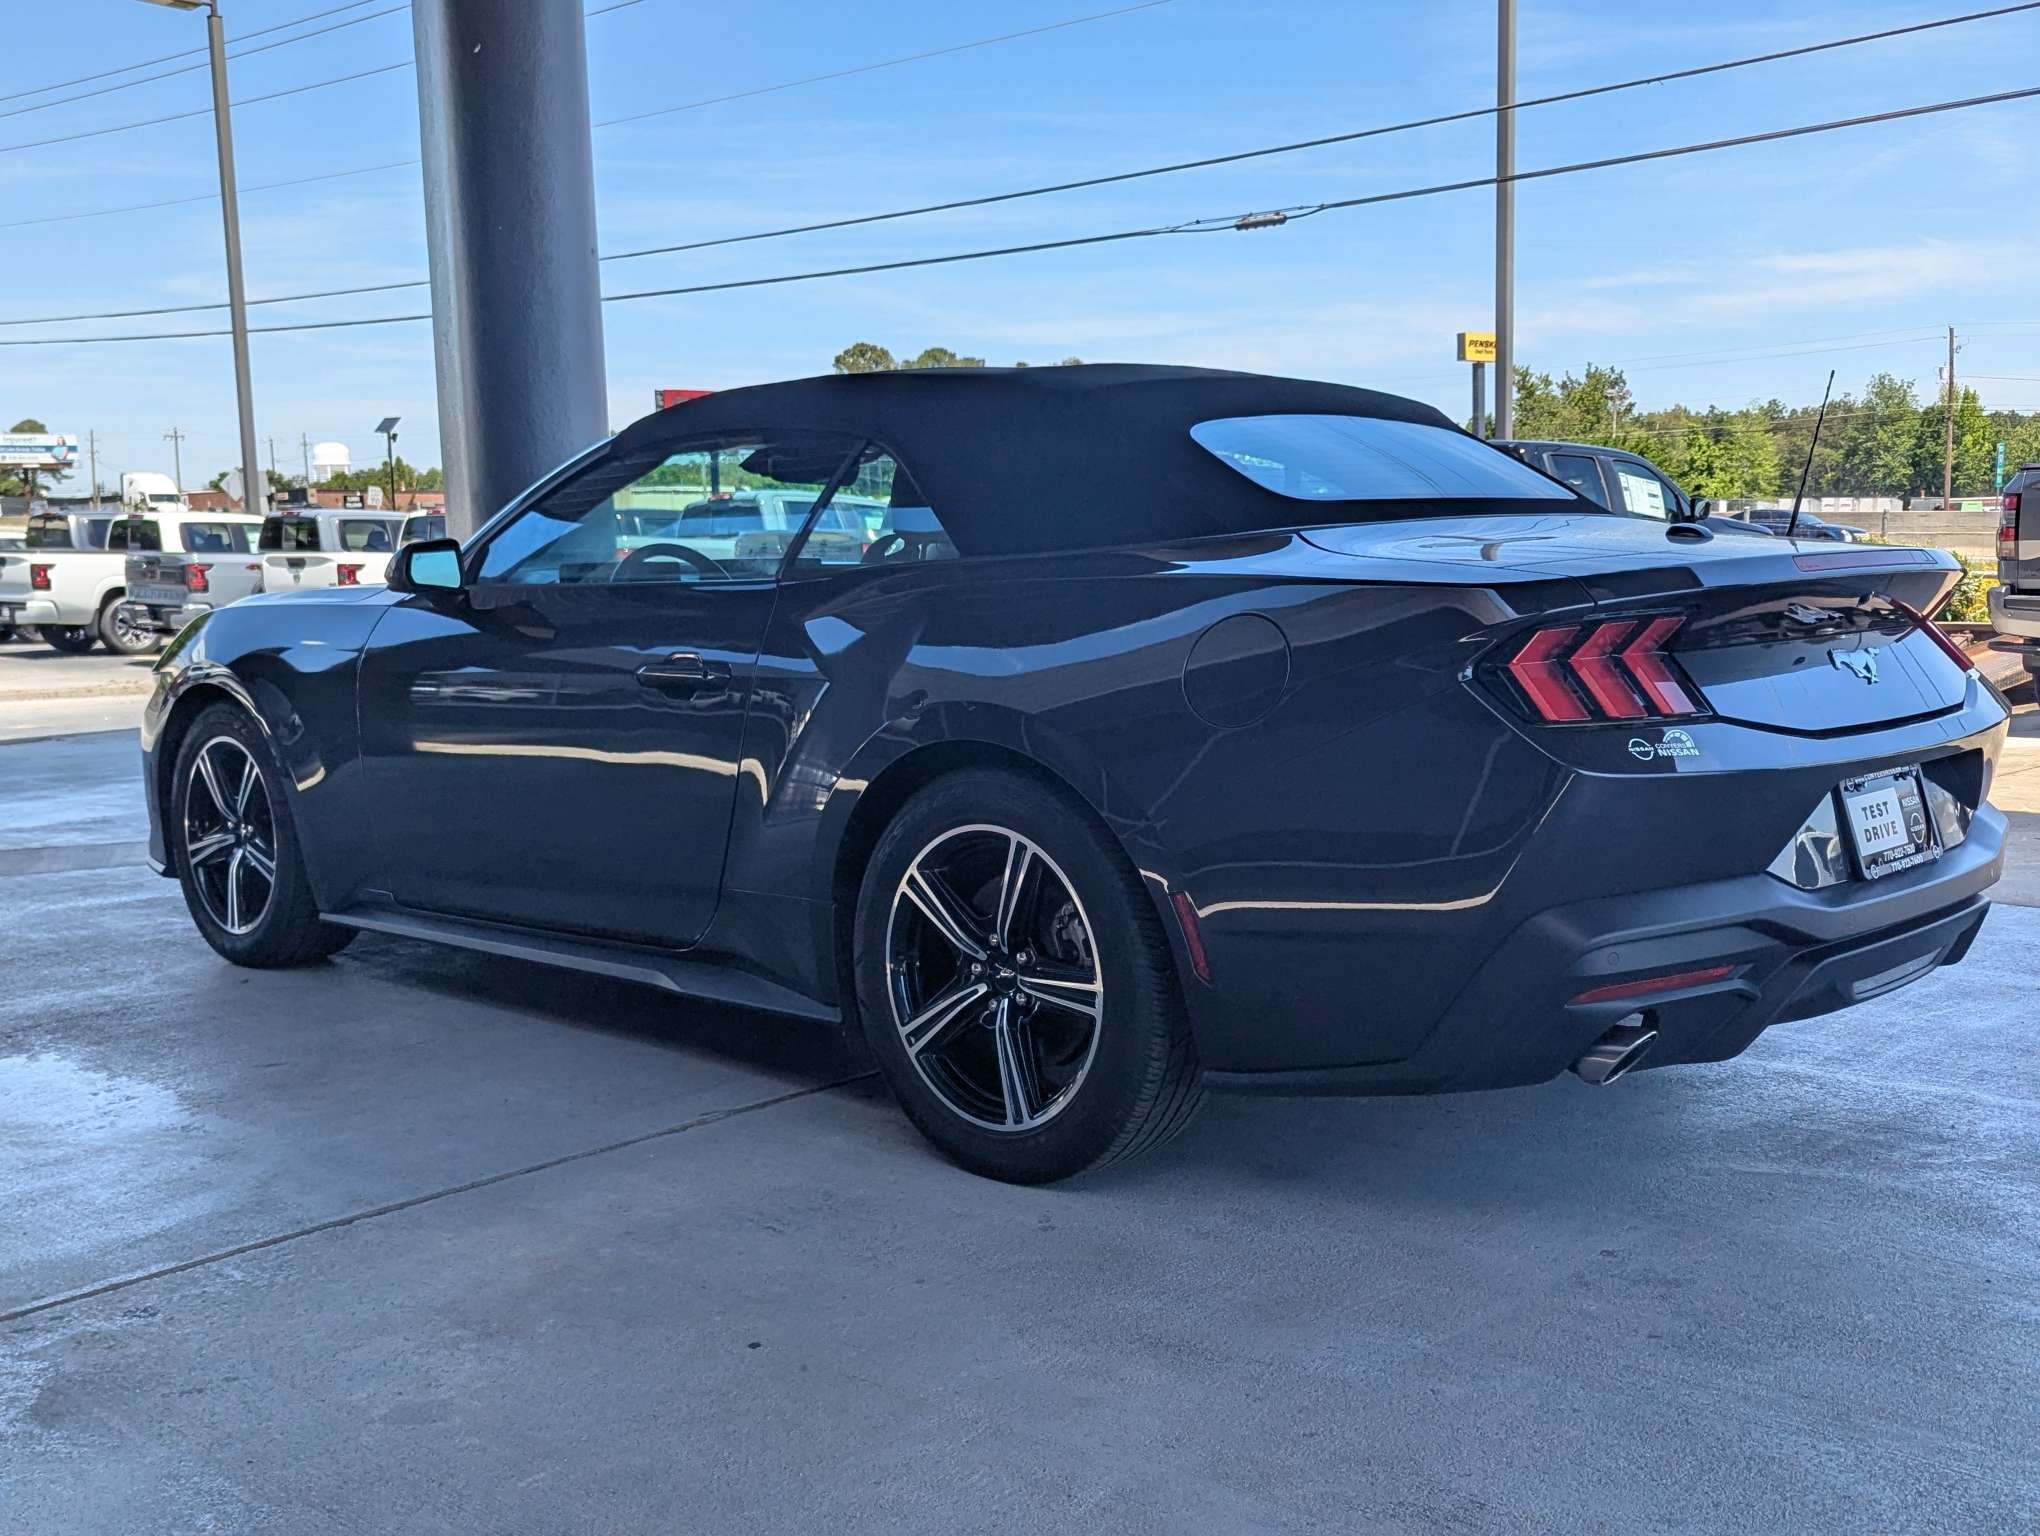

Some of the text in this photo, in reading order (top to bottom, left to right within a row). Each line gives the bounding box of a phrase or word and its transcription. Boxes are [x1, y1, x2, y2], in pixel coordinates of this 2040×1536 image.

[1468, 339, 1497, 349] PENSK
[1657, 748, 1700, 756] NISSAN
[1901, 796, 1920, 807] NISSAN
[1861, 801, 1890, 821] TEST
[1864, 820, 1899, 843] DRIVE
